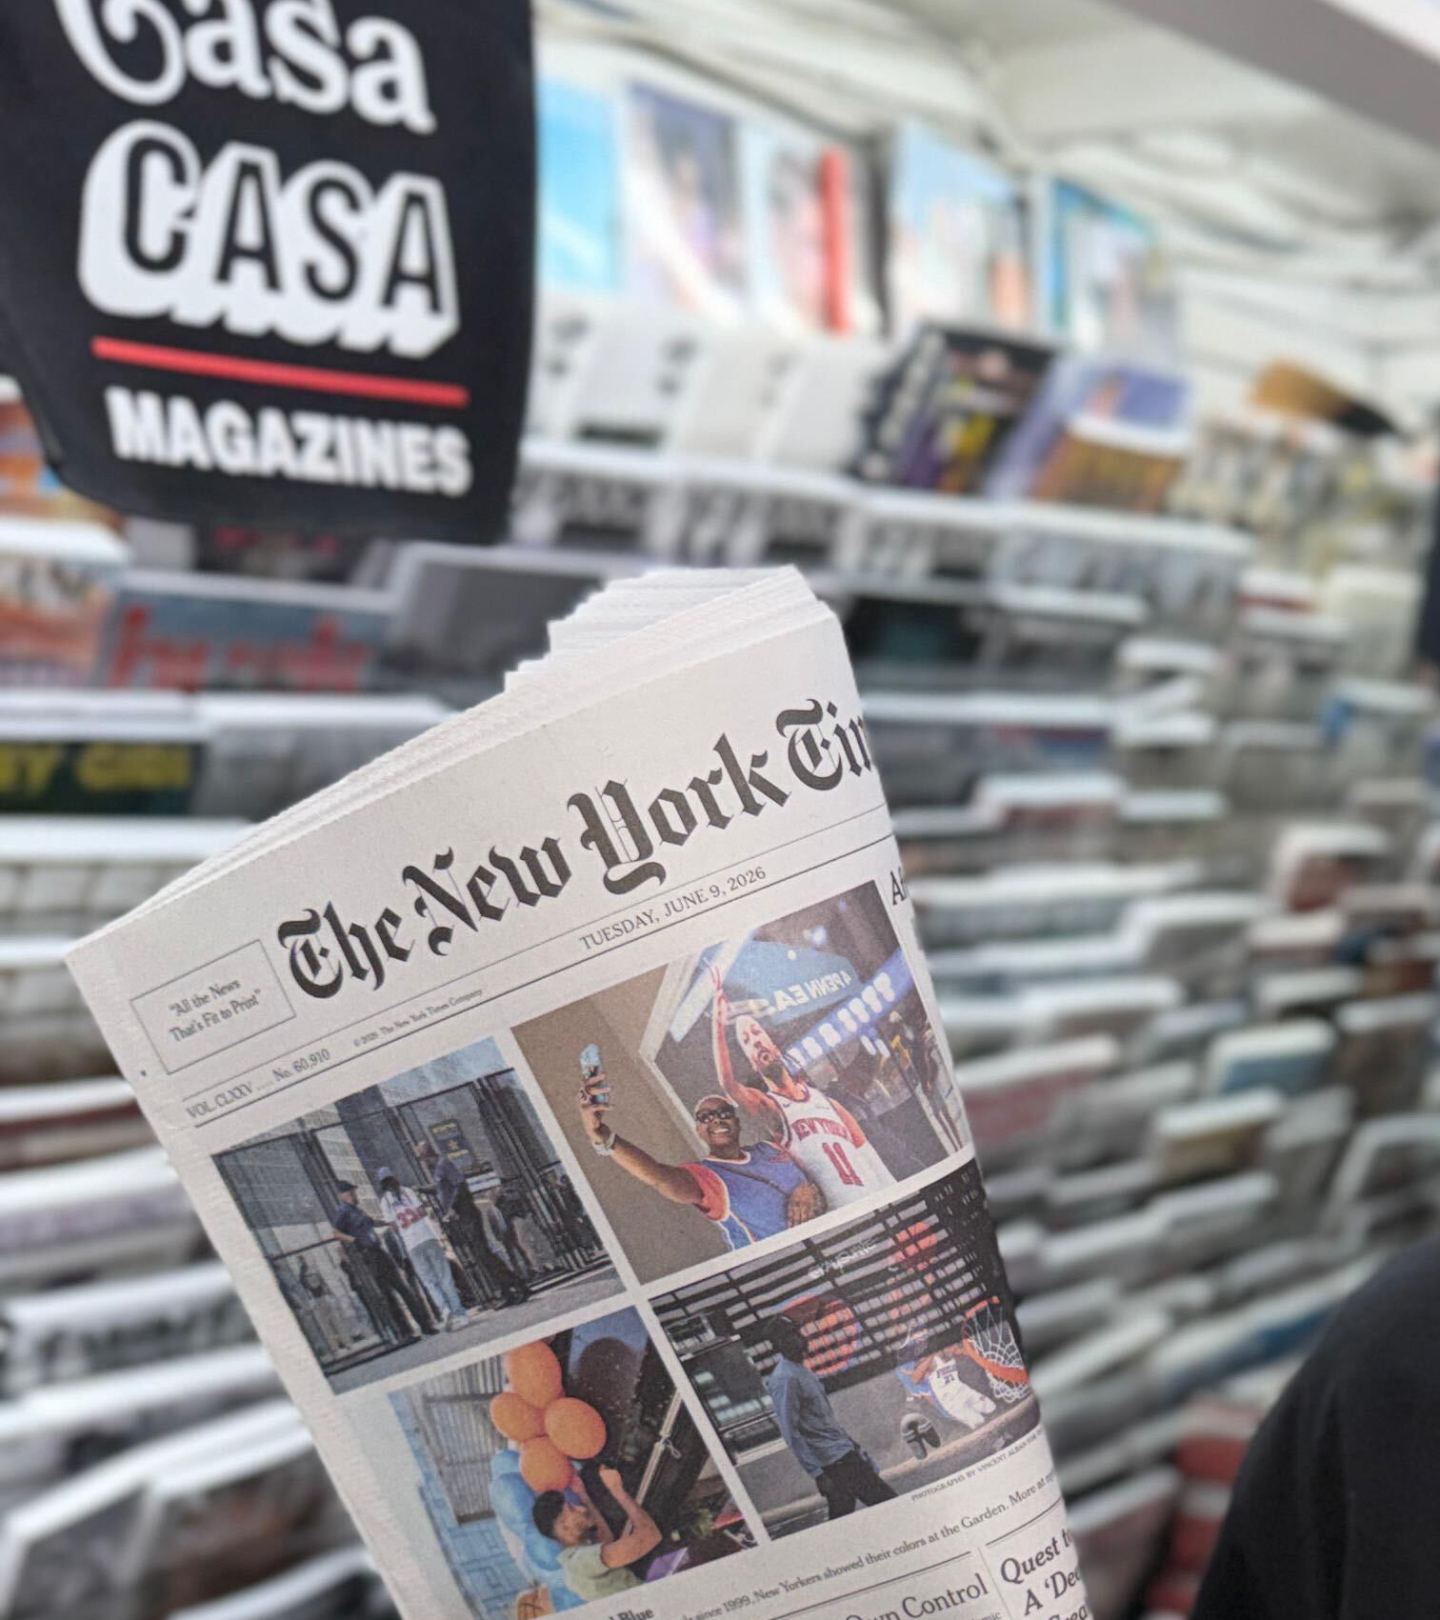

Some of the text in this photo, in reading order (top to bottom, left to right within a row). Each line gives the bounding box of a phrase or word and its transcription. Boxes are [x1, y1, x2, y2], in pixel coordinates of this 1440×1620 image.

[55, 0, 436, 134] Casa
[78, 120, 460, 358] CASA
[105, 386, 472, 496] MAGAZINES
[277, 901, 416, 999] The
[402, 846, 572, 957] New
[567, 732, 792, 895] York
[580, 866, 767, 950] TUESDAY, JUNE 9, 2026
[169, 980, 241, 1017] "All the News
[169, 988, 262, 1042] That's Fit to Print"
[213, 1082, 253, 1108] CLXXV
[271, 1067, 293, 1082] No.
[291, 1048, 331, 1073] 60,910
[722, 1595, 756, 1612] 1999,
[752, 1587, 781, 1603] New
[778, 1574, 822, 1594] Yorkers
[823, 1555, 865, 1579] showed
[864, 1548, 891, 1565] their
[892, 1537, 927, 1555] colors
[927, 1532, 940, 1544] at
[940, 1524, 961, 1538] the
[961, 1503, 1009, 1529] Garden.
[1007, 1485, 1037, 1507] More
[1000, 1536, 1061, 1585] Quest
[902, 1572, 989, 1619] Control
[1024, 1588, 1044, 1616] A
